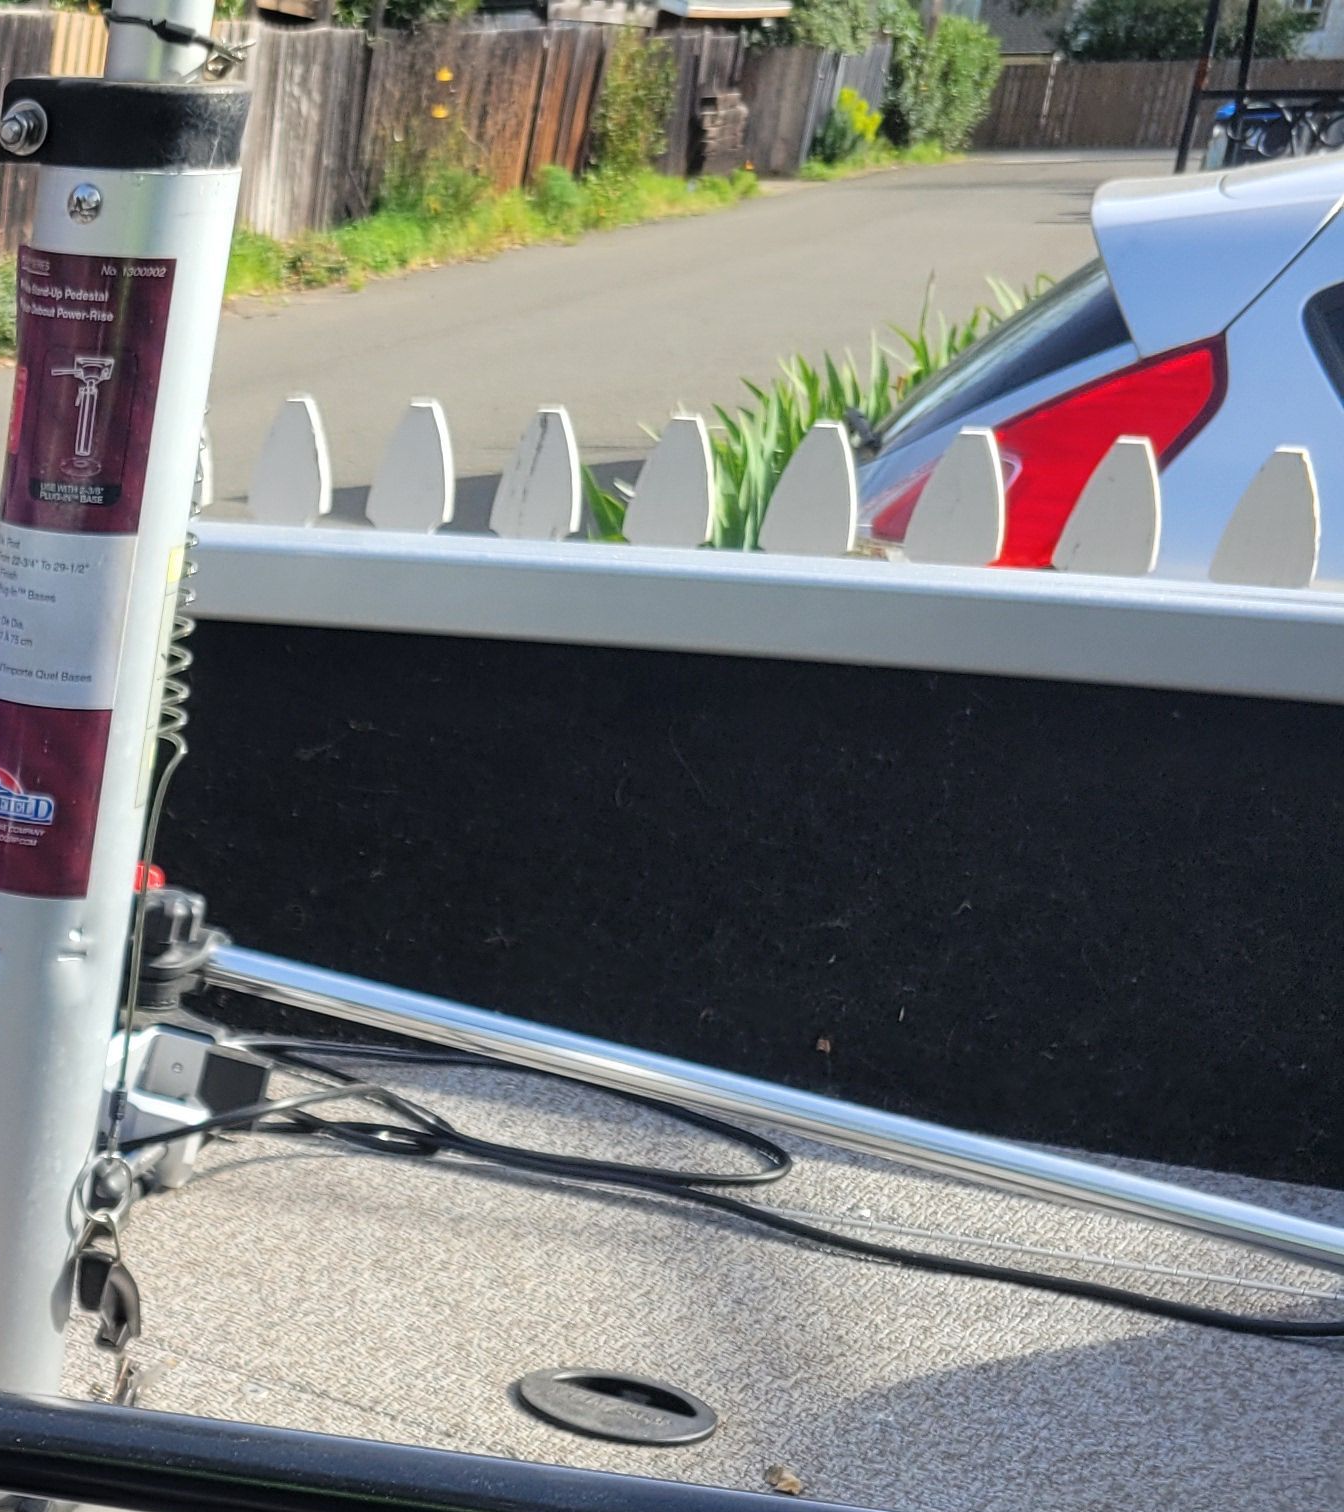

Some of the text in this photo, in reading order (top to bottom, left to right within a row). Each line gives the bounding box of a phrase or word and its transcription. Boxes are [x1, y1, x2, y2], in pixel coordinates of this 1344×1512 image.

[64, 287, 109, 302] Pedestal
[56, 308, 114, 322] Power-Rise
[79, 495, 103, 504] BASE
[42, 560, 51, 570] To
[53, 562, 89, 574] 29-1/2"
[35, 669, 58, 681] Quel
[61, 671, 92, 682] Bases
